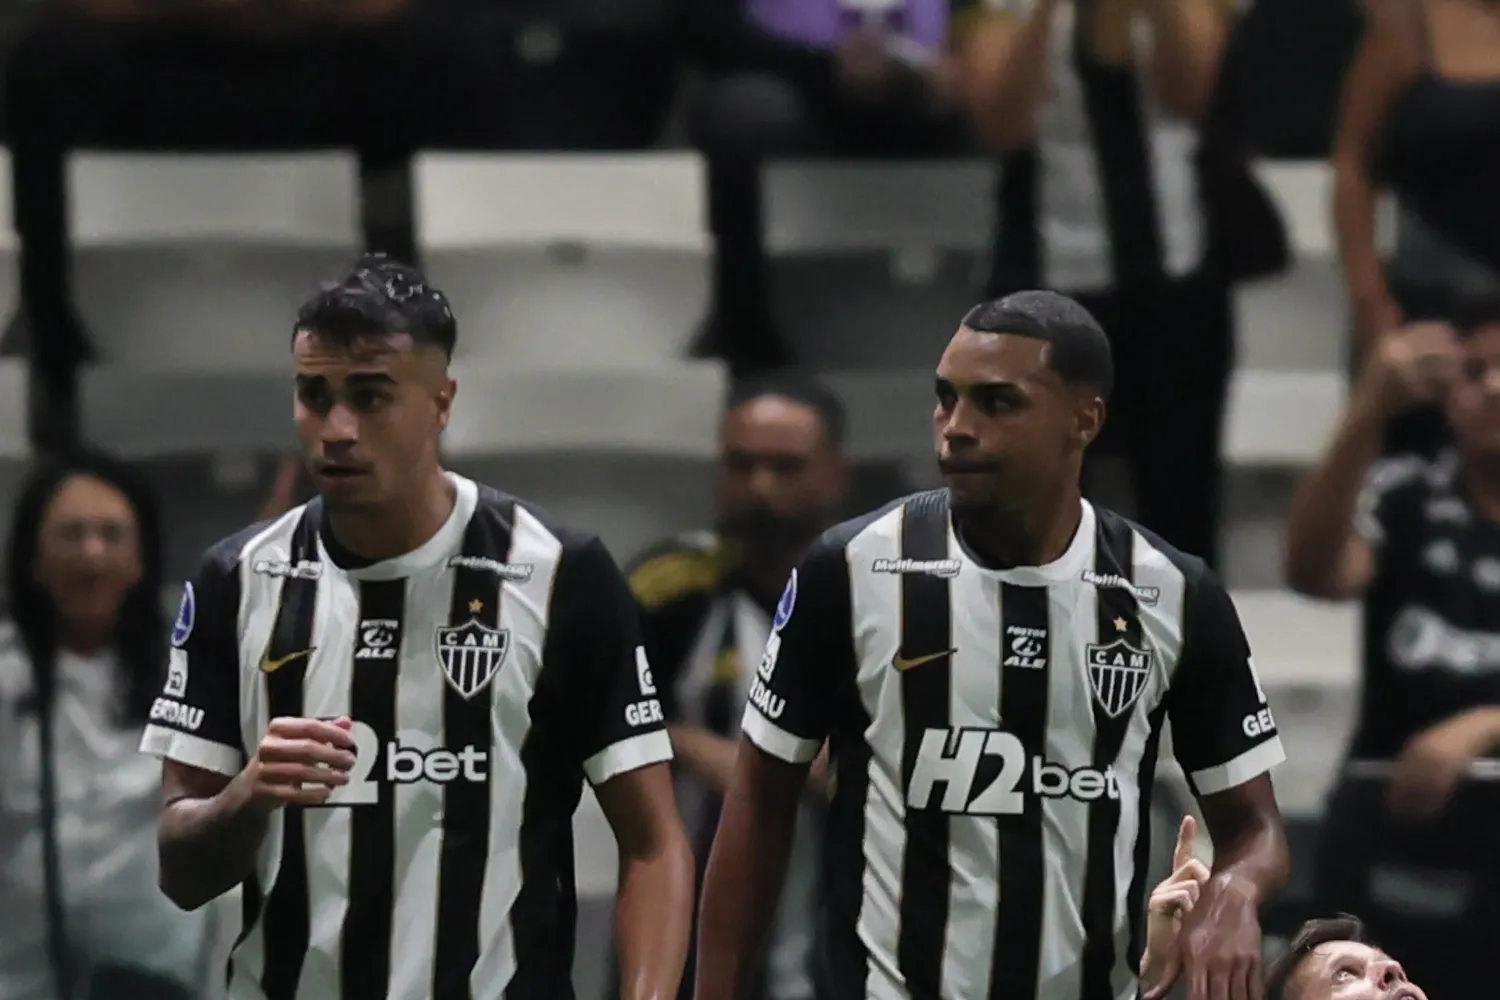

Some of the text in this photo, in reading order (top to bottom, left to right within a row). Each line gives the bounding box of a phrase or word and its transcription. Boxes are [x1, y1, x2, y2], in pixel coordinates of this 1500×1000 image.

[445, 633, 499, 647] CAM
[355, 648, 397, 659] ALE
[1095, 651, 1144, 668] CAM
[1003, 655, 1047, 669] ALE
